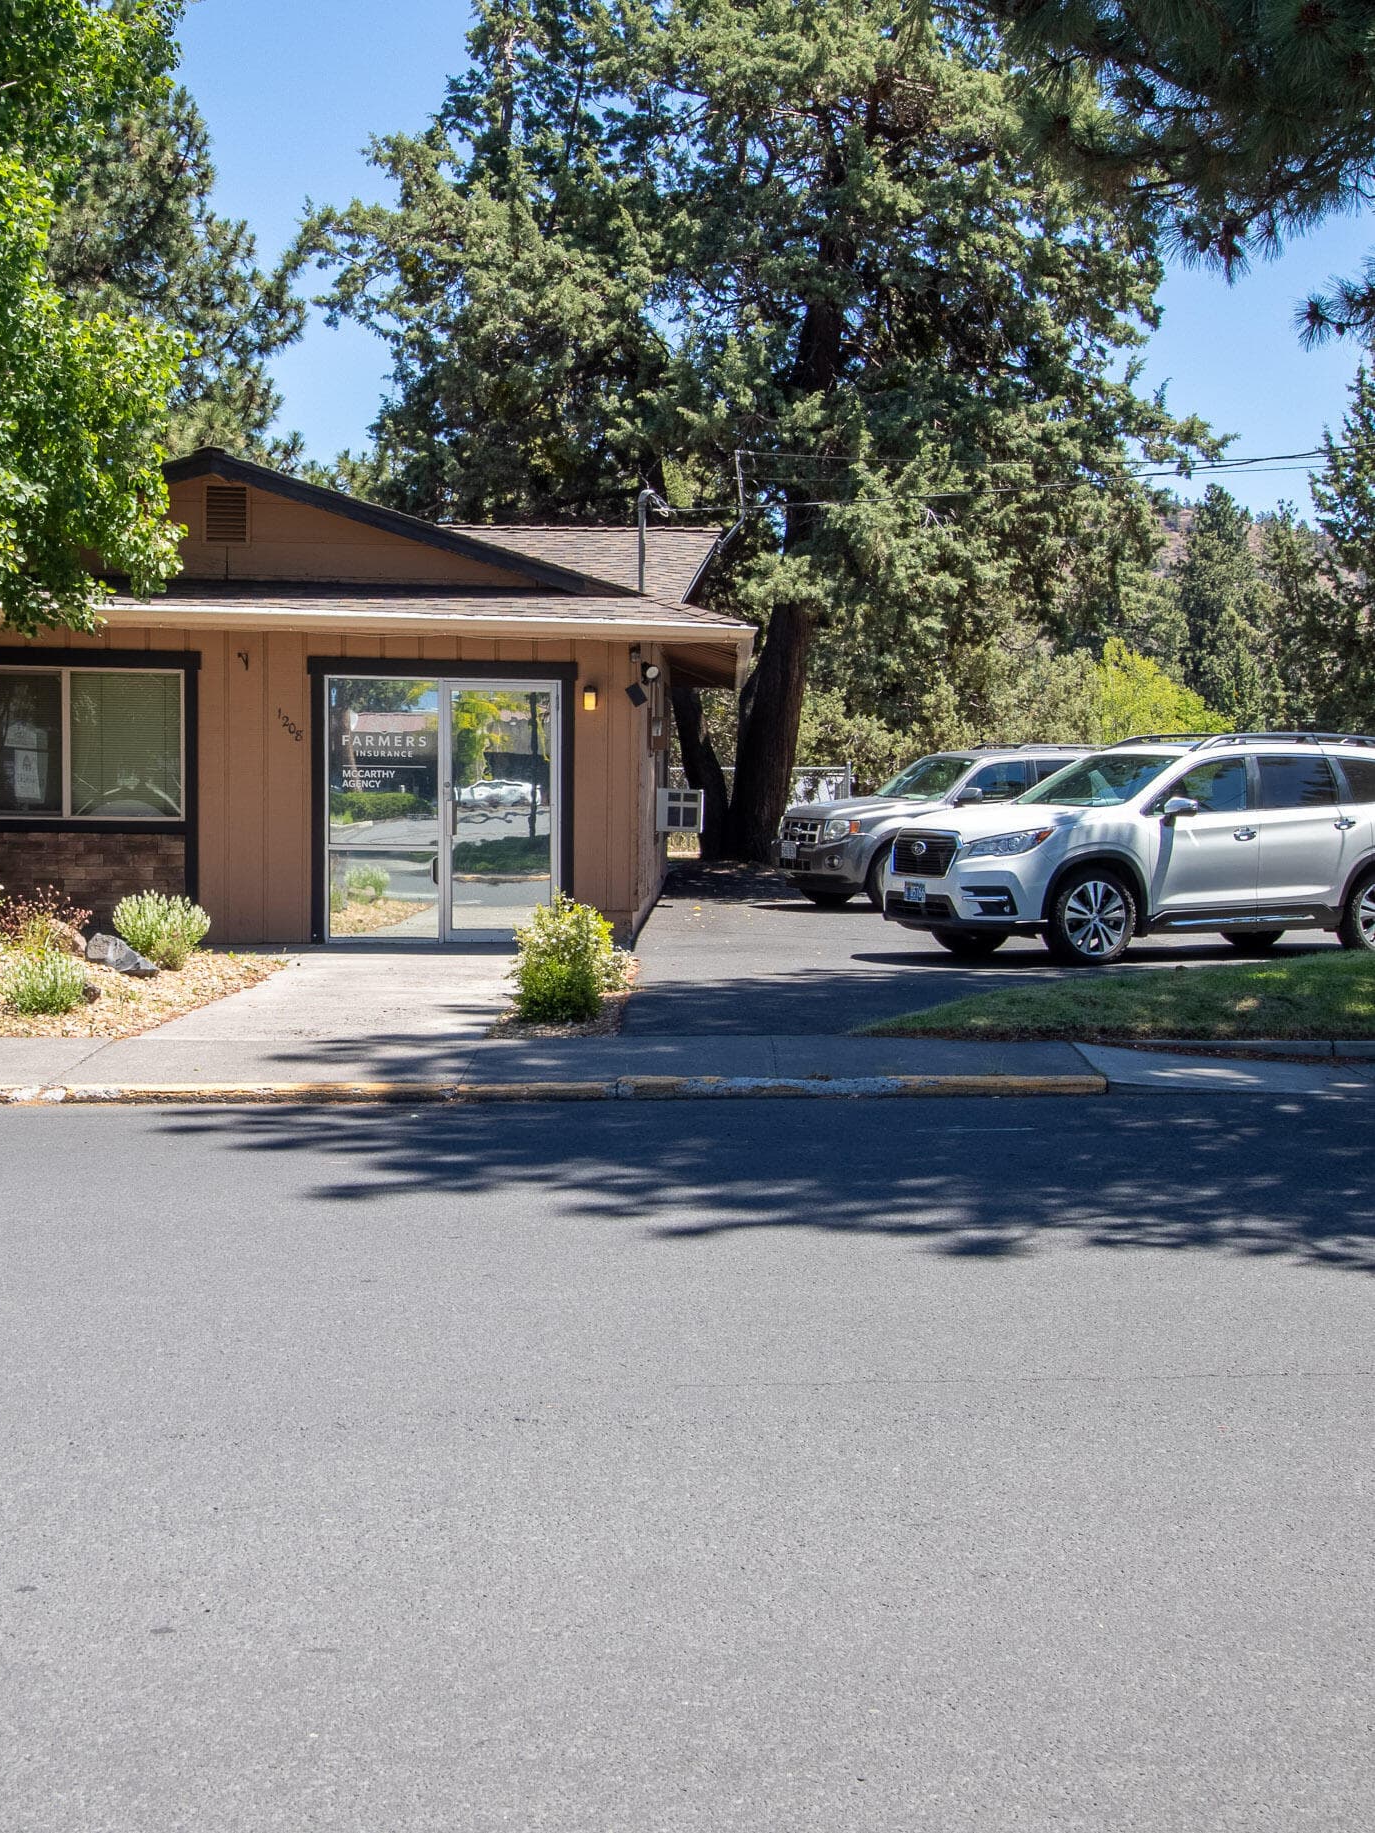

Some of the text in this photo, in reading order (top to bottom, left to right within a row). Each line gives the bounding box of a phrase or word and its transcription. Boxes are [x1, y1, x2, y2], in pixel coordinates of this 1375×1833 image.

[277, 707, 304, 742] 1208
[341, 734, 427, 748] FARMERS
[355, 750, 414, 758] INSURANCE
[342, 769, 395, 779] MCCARTHY
[341, 779, 382, 788] AGENCY
